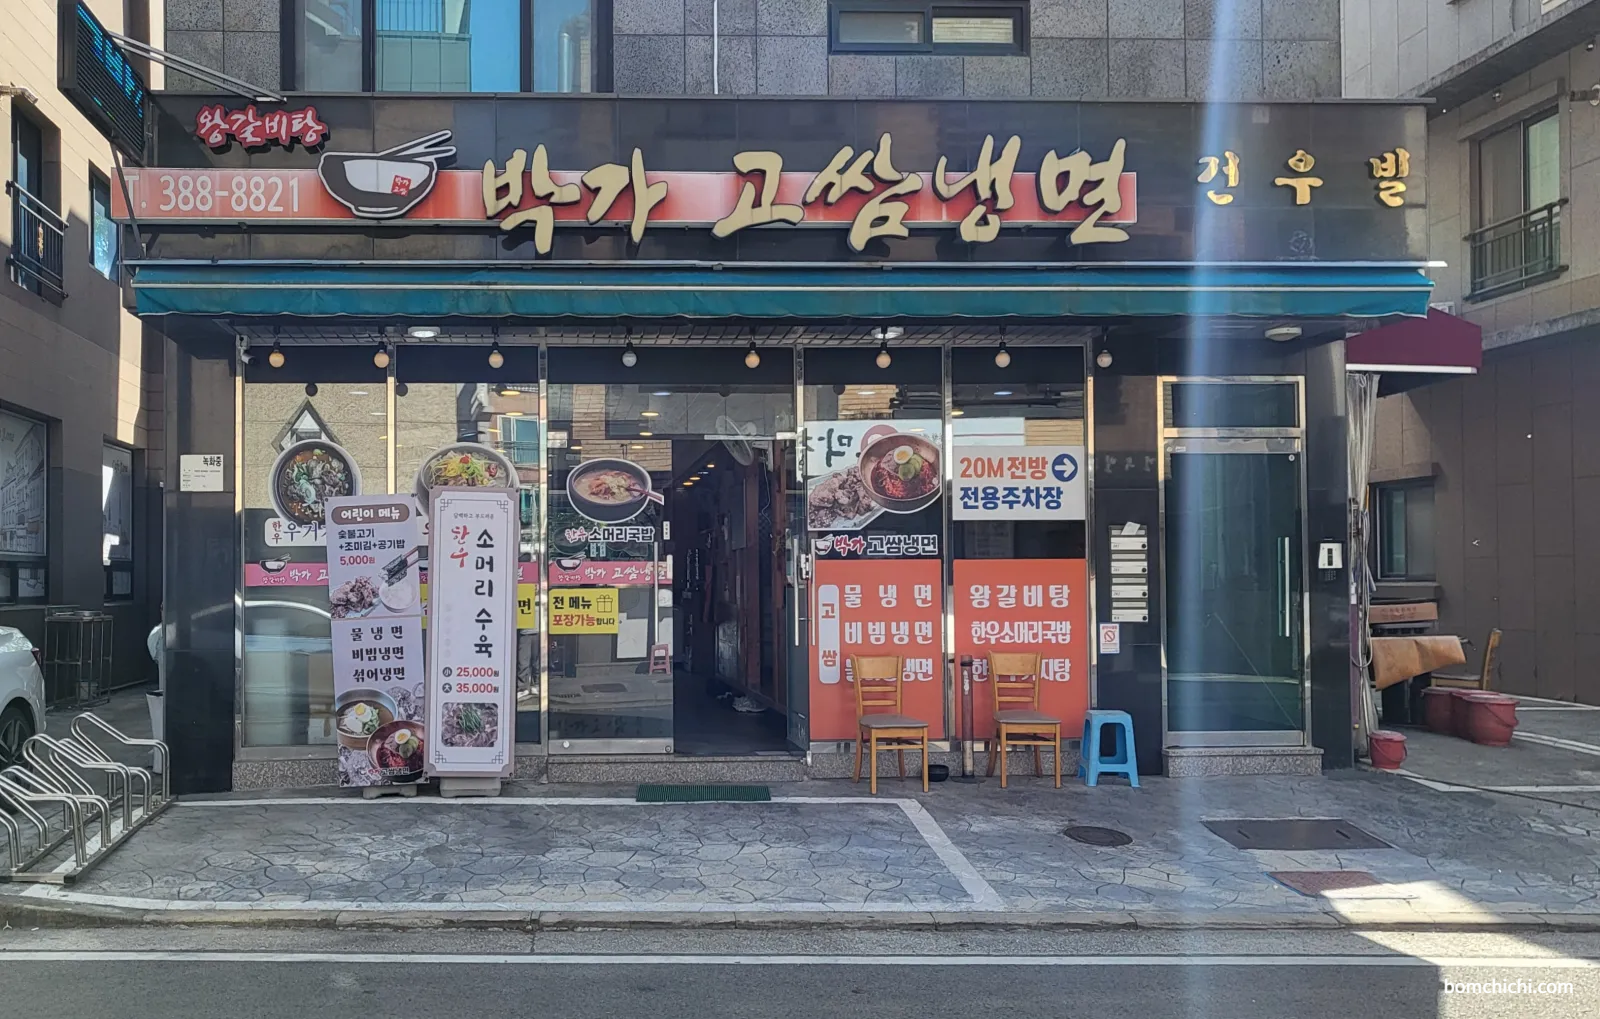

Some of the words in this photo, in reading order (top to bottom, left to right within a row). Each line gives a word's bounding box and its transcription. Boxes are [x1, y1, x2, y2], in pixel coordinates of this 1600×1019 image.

[199, 108, 324, 145] 왕갈비탕
[159, 174, 300, 213] 388-8821
[482, 143, 668, 255] 박가
[710, 132, 1131, 252] 고쌈냉면
[202, 456, 222, 467] 녹화중
[959, 457, 1005, 479] 20M
[1007, 456, 1049, 480] 전방
[959, 486, 1064, 510] 전용주차장
[340, 508, 375, 522] 어린이
[377, 506, 401, 520] 메뉴
[271, 521, 283, 545] 한우
[565, 526, 588, 543] 한우
[588, 526, 655, 543] 소머리국밥
[834, 535, 867, 556] 박가
[867, 534, 939, 555] 고쌈냉면
[449, 525, 471, 569] 한우
[339, 555, 376, 566] 5,000원
[473, 528, 495, 659] 소머리수육
[552, 596, 565, 610] 전
[568, 596, 593, 610] 메뉴
[844, 584, 933, 609] 물냉면
[969, 584, 1071, 609] 왕갈비탕
[350, 625, 404, 642] 물냉면
[821, 602, 838, 668] 고쌈
[844, 621, 933, 645] 비빔냉면
[971, 620, 1072, 645] 한우소머리국밥
[351, 645, 405, 662] 비빔냉면
[352, 666, 406, 683] 섞어냉면
